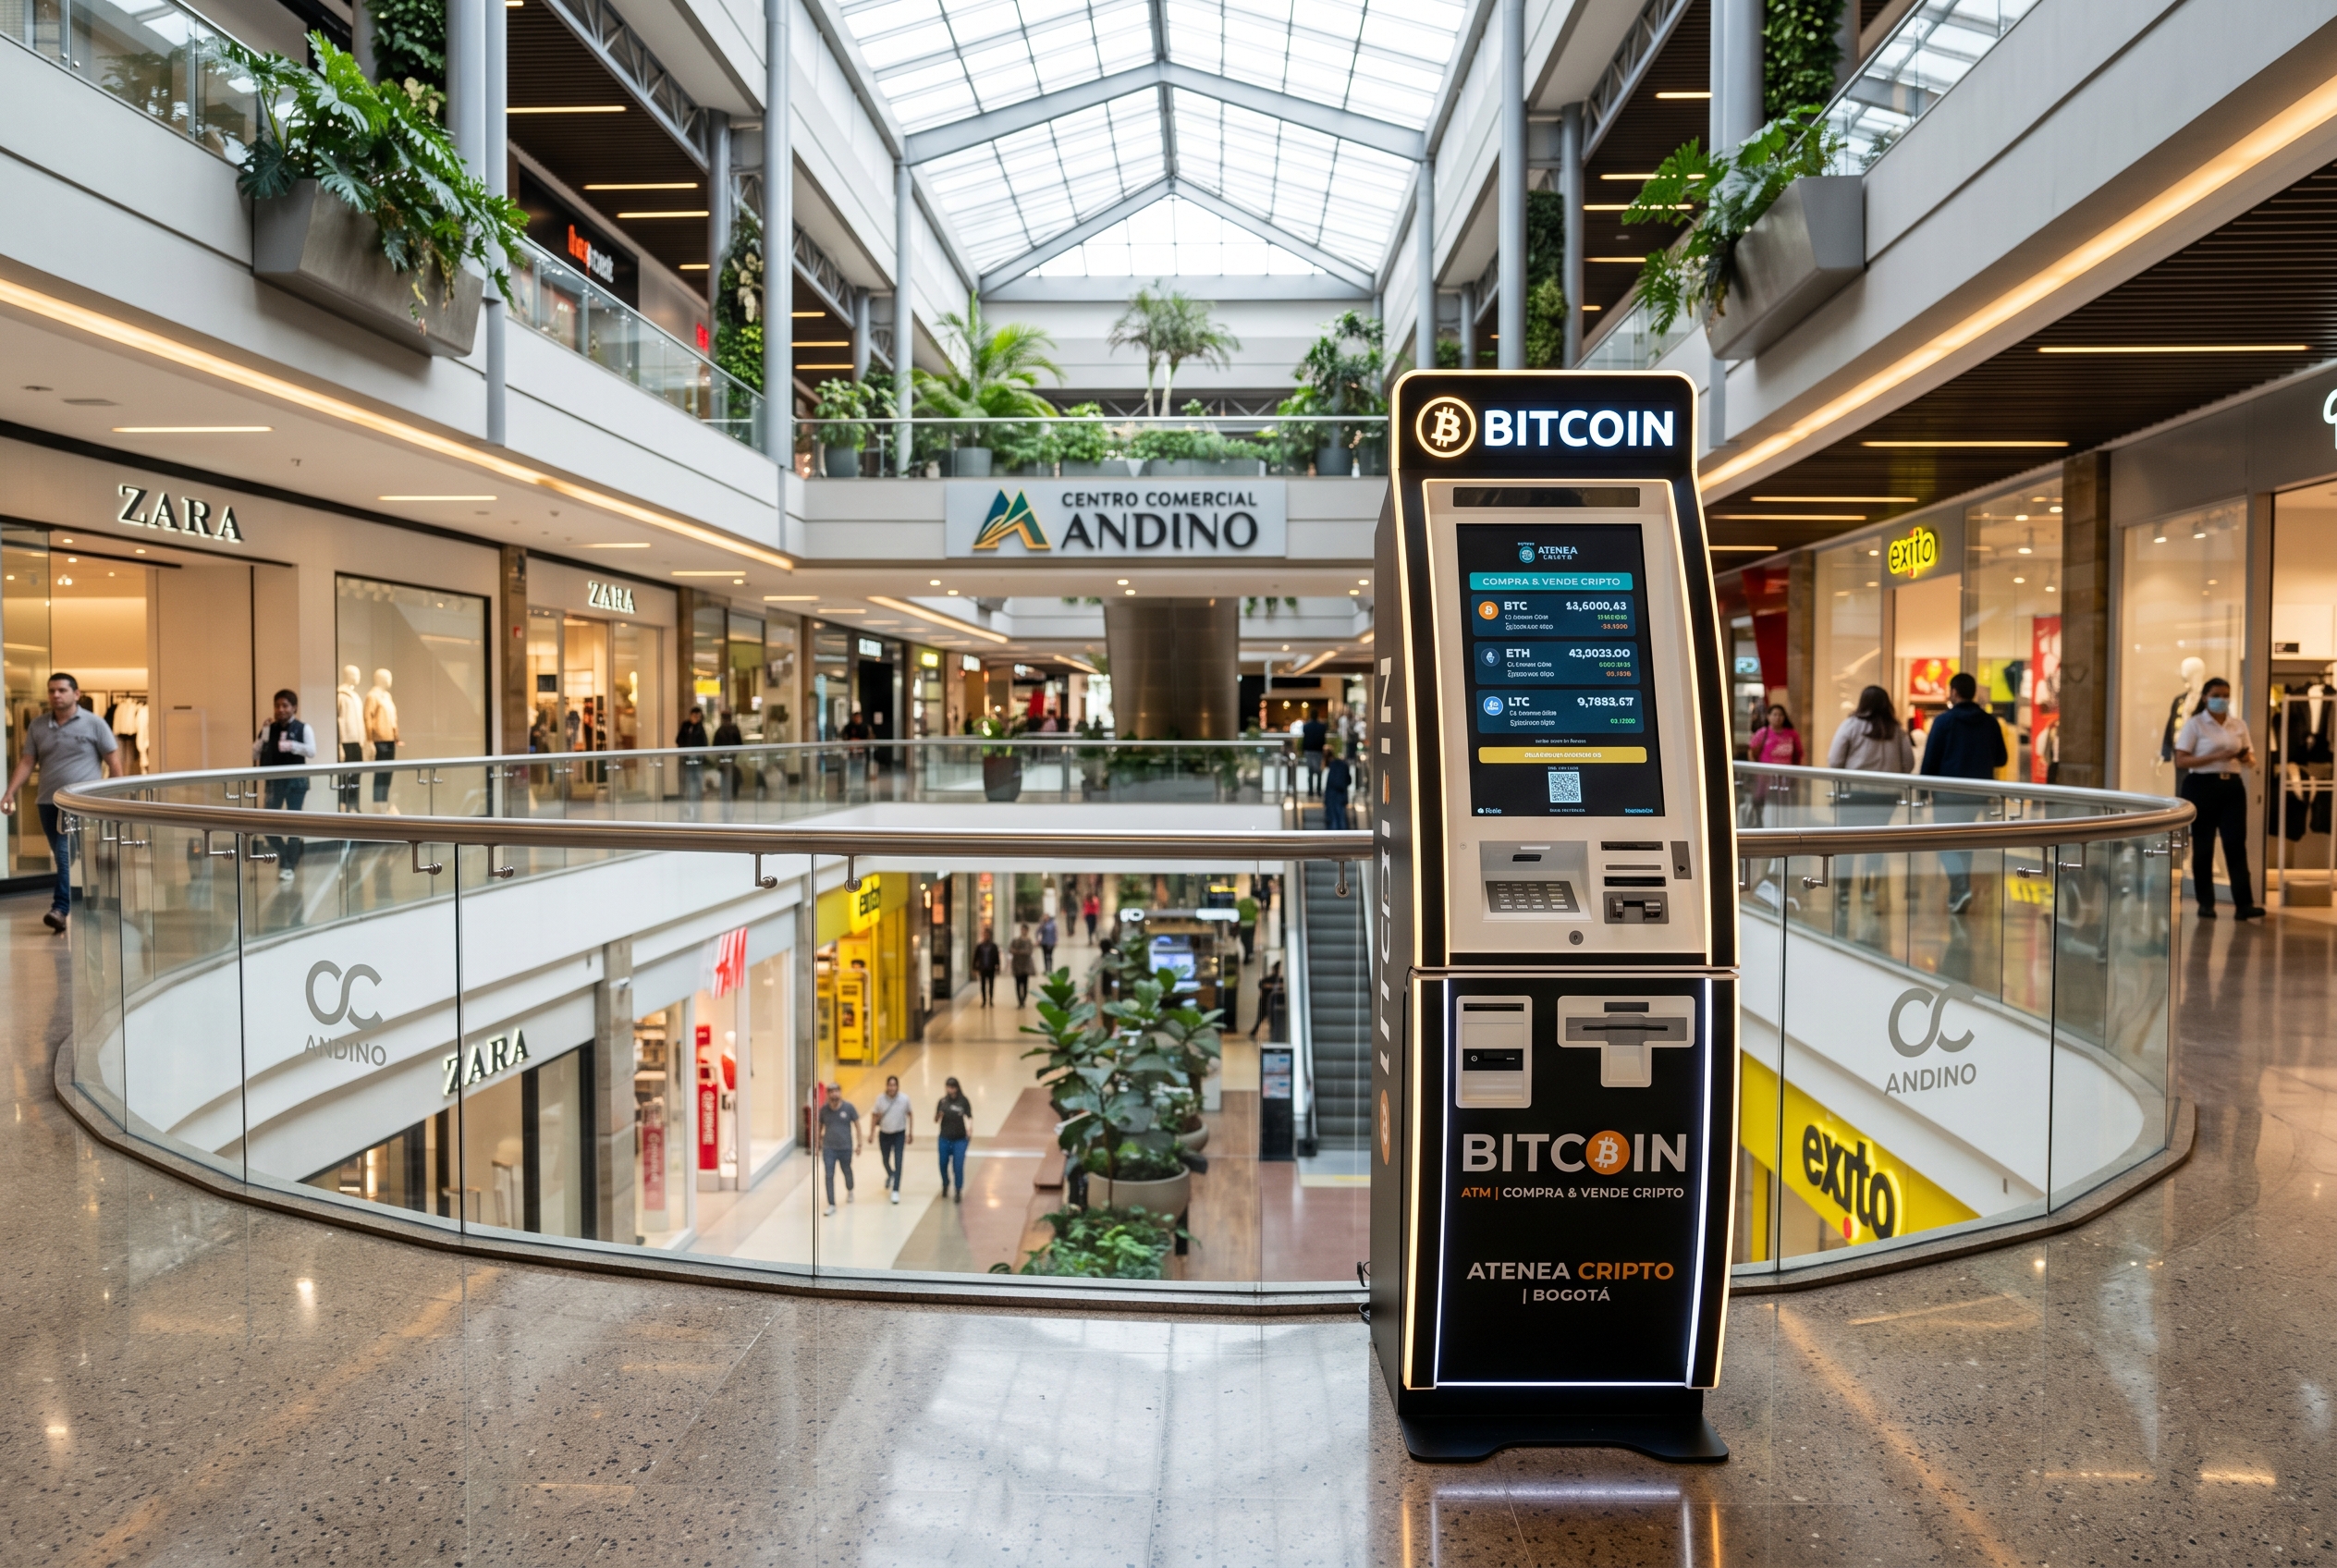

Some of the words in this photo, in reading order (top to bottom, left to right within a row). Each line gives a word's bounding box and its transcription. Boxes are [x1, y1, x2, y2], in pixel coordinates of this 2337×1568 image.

[1485, 410, 1674, 447] BITCOIN
[1061, 492, 1139, 508] CENTRO
[1145, 492, 1258, 508] COMERCIAL
[117, 484, 245, 543] ZARA
[1060, 511, 1259, 551] ANDINO
[1537, 546, 1578, 555] ATENEA
[588, 580, 636, 614] ZARA
[1504, 601, 1527, 610] BTC
[1506, 648, 1530, 657] ETH
[1509, 697, 1530, 706] LTC
[304, 1035, 386, 1067] ANDINO
[443, 1027, 532, 1096] ZARA
[1884, 1062, 1976, 1096] ANDINO
[1462, 1188, 1491, 1197] ATM
[1502, 1187, 1564, 1198] COMPRA
[1568, 1187, 1577, 1198] &
[1581, 1187, 1629, 1198] VENDE
[1633, 1187, 1684, 1198] CRIPTO
[1466, 1262, 1571, 1280] ATENEA
[1578, 1262, 1674, 1280] CRIPTO
[1534, 1286, 1611, 1302] BOGOTÁ
